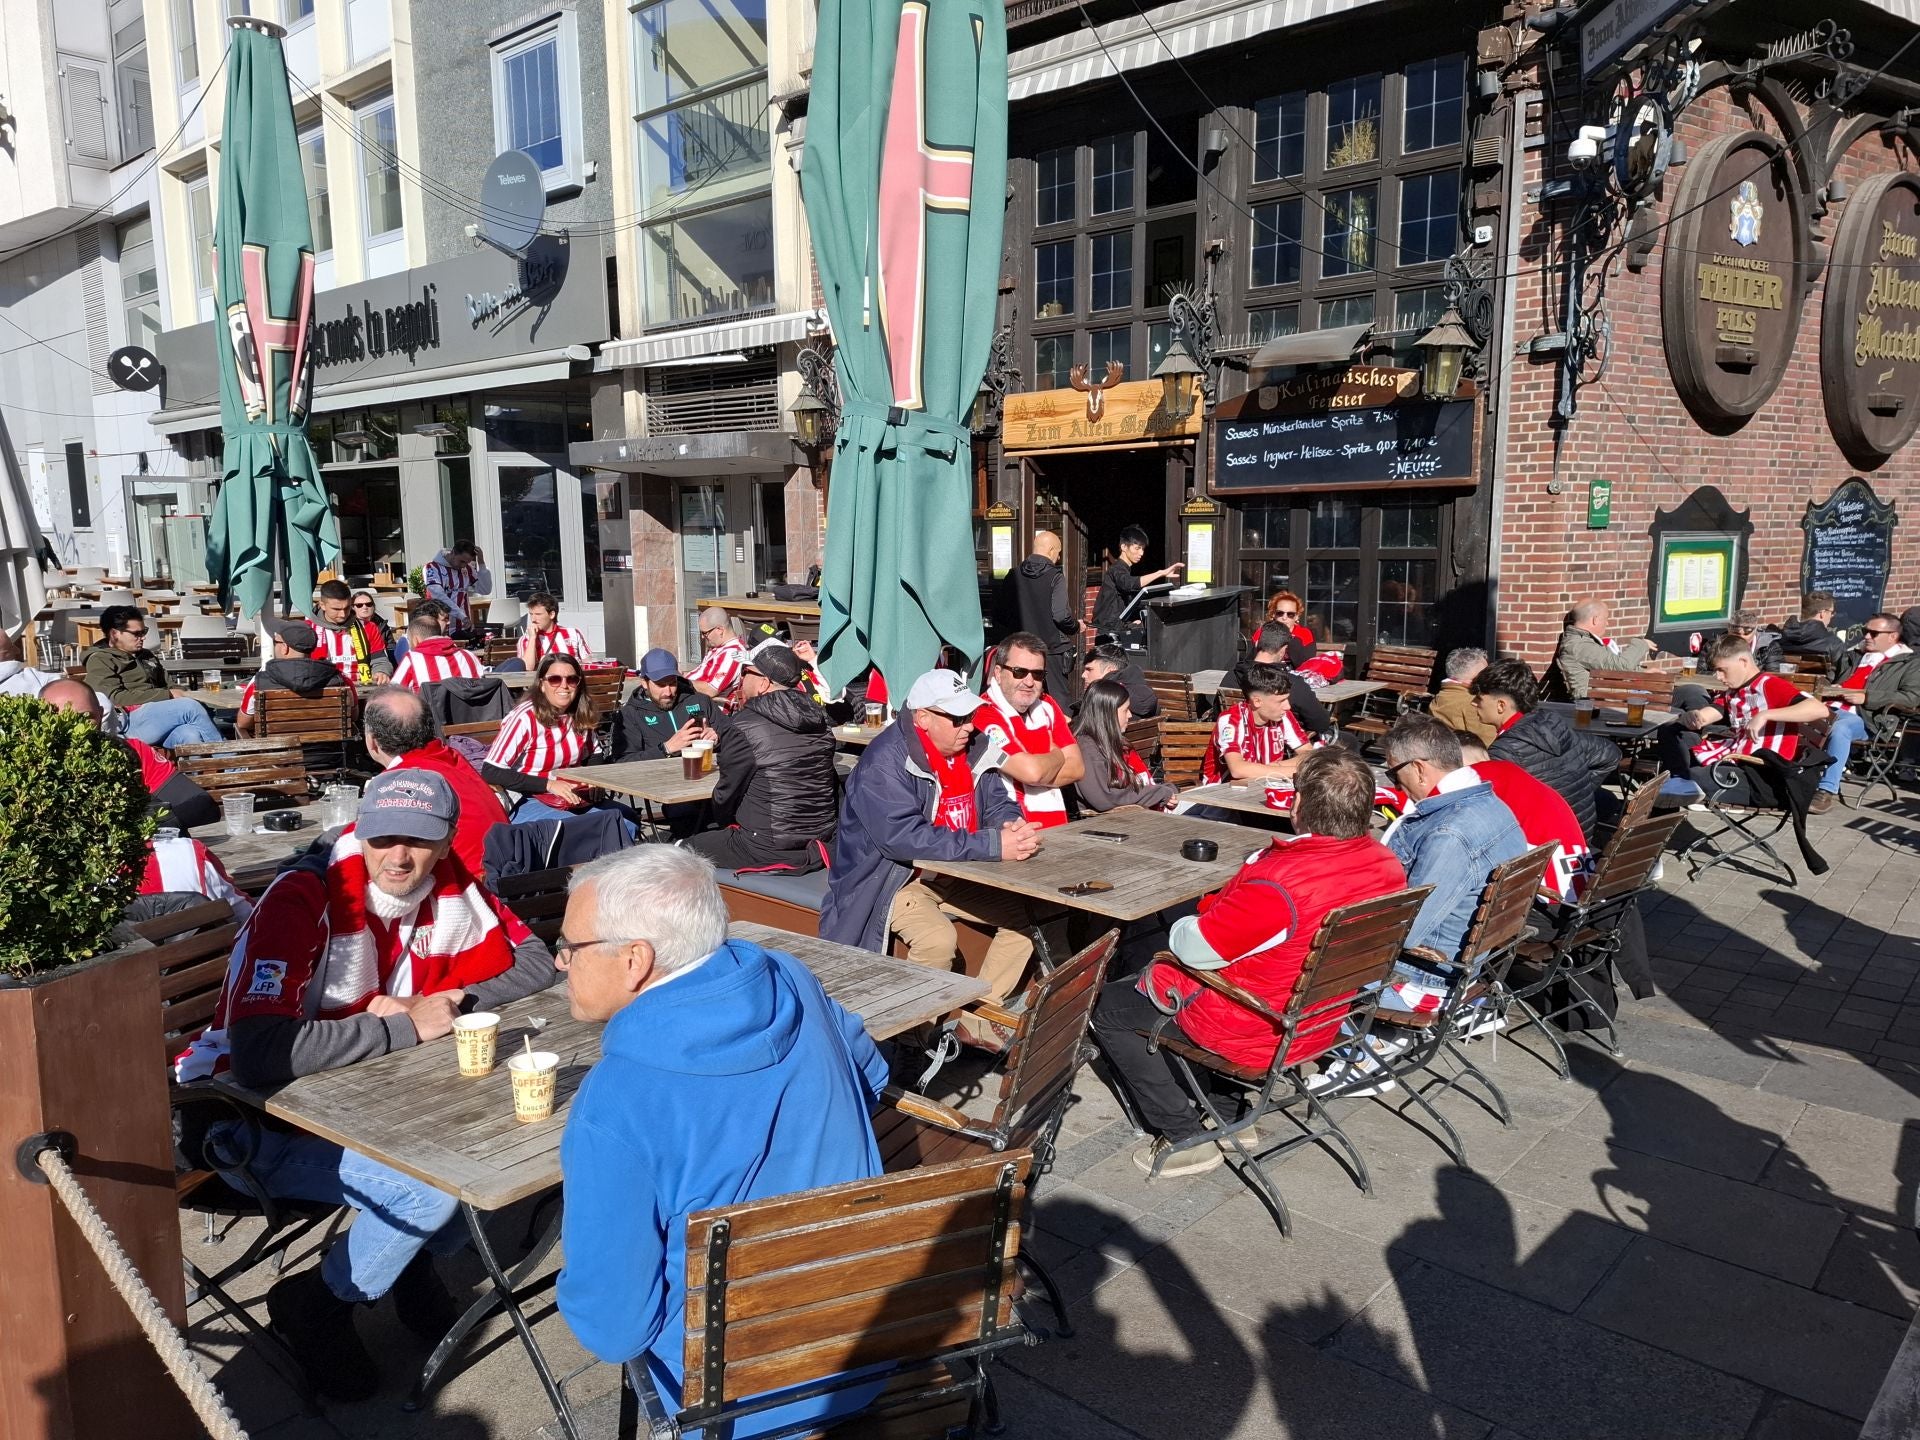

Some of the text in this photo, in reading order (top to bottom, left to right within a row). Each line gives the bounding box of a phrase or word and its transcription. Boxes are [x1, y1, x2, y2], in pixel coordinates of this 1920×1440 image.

[498, 174, 526, 186] Televes
[1880, 219, 1918, 261] Zum
[1698, 263, 1783, 311] THIER
[385, 282, 441, 367] napoli
[1716, 307, 1757, 334] PILS
[1278, 367, 1397, 400] Kulinarisches
[1308, 392, 1366, 409] Fenster
[1026, 422, 1062, 443] Zum
[1069, 417, 1113, 439] Alten
[1331, 414, 1364, 432] Spritz
[1396, 460, 1436, 475] NEU!!!
[376, 798, 433, 811] PATRIOTS
[254, 981, 275, 992] LFP
[513, 1077, 548, 1088] COFFEE
